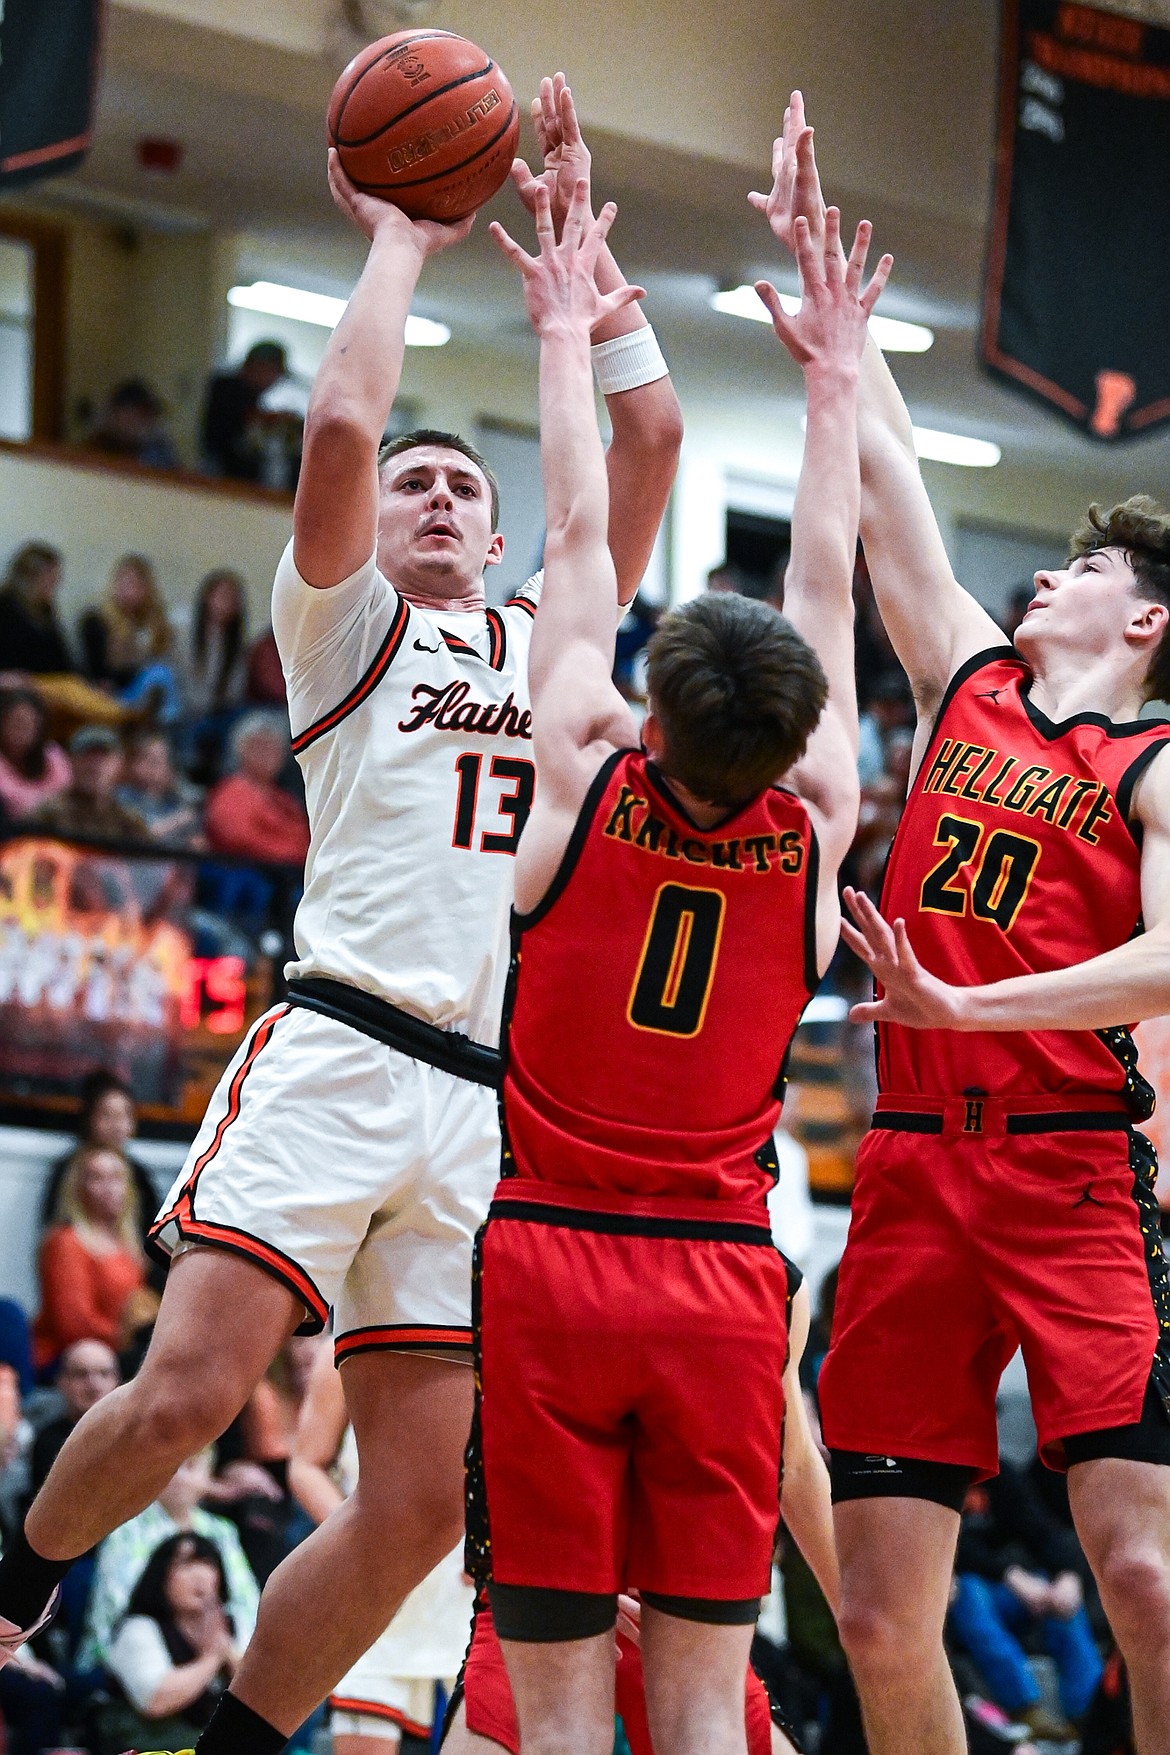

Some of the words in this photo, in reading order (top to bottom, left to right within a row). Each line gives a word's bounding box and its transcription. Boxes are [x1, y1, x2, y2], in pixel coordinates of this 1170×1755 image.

[452, 752, 537, 856] 13
[922, 738, 1113, 846] HELLGATE
[918, 812, 1042, 934] 20
[626, 881, 727, 1039] 0
[963, 1100, 984, 1133] H
